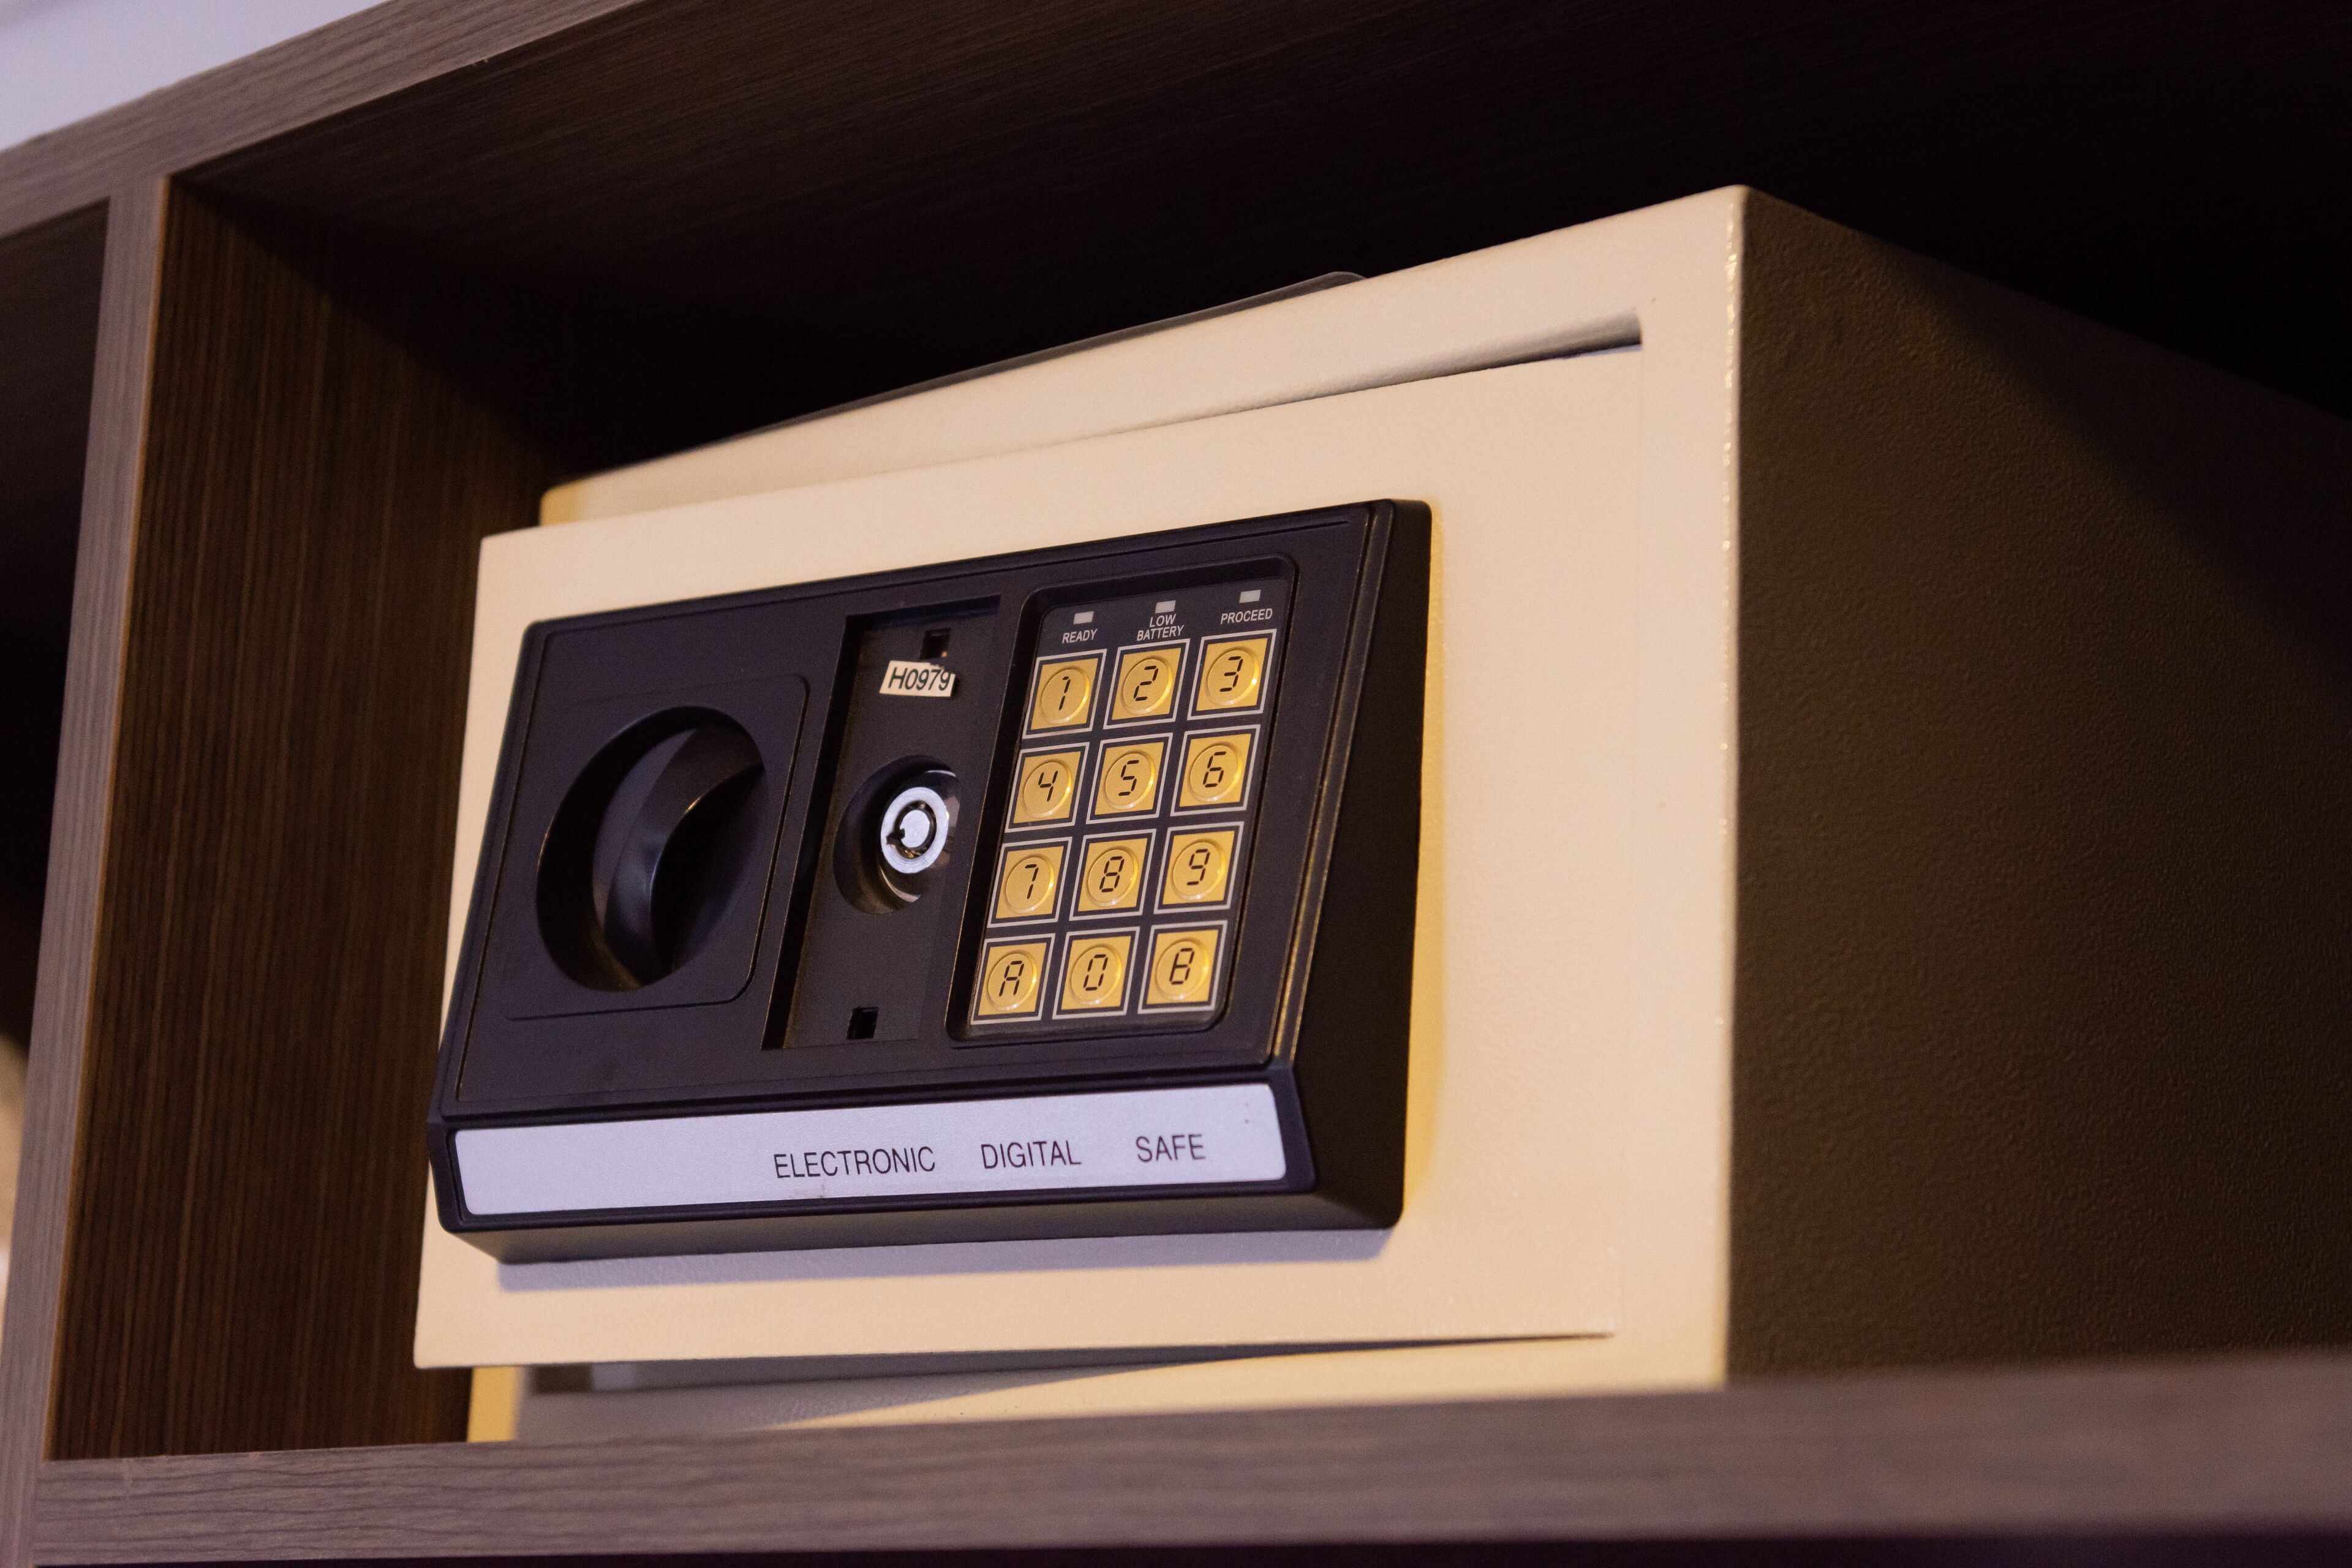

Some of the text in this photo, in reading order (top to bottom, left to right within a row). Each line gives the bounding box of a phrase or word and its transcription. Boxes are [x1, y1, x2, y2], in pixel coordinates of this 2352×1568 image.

[1136, 625, 1184, 641] BATTERY
[1149, 614, 1176, 628] LOW
[1220, 608, 1273, 625] PROCEED
[1061, 628, 1098, 644] READY
[888, 667, 950, 691] H0979
[1133, 665, 1158, 701] 2
[1219, 656, 1243, 692] 3
[1059, 676, 1069, 710] 1
[1038, 770, 1058, 802] 4
[1118, 760, 1139, 796] 5
[1203, 752, 1226, 788] 6
[1025, 864, 1039, 899] 7
[1099, 856, 1124, 892] 8
[1186, 849, 1210, 885] 9
[999, 960, 1024, 997] A
[1083, 954, 1108, 991] 0
[774, 1134, 1207, 1179] ELECTRONIC DIGITAL SAFE
